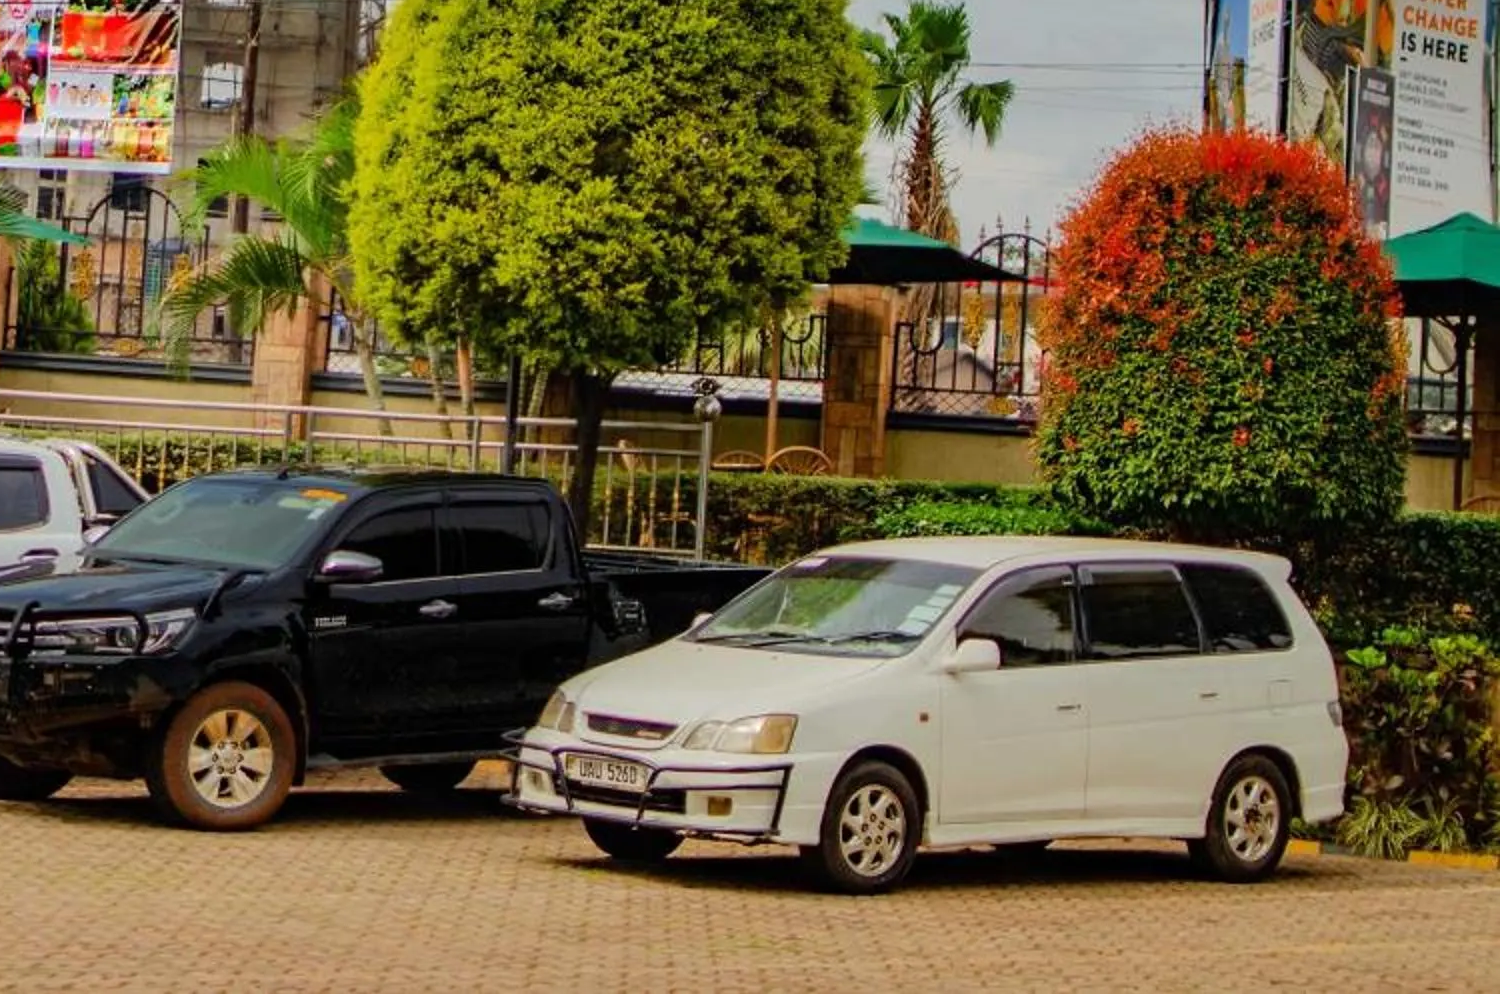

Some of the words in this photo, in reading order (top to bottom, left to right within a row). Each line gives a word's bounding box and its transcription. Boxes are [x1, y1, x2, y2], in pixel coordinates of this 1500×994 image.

[1403, 5, 1478, 39] CHANGE
[1401, 31, 1417, 52] IS
[1422, 35, 1469, 63] HERE
